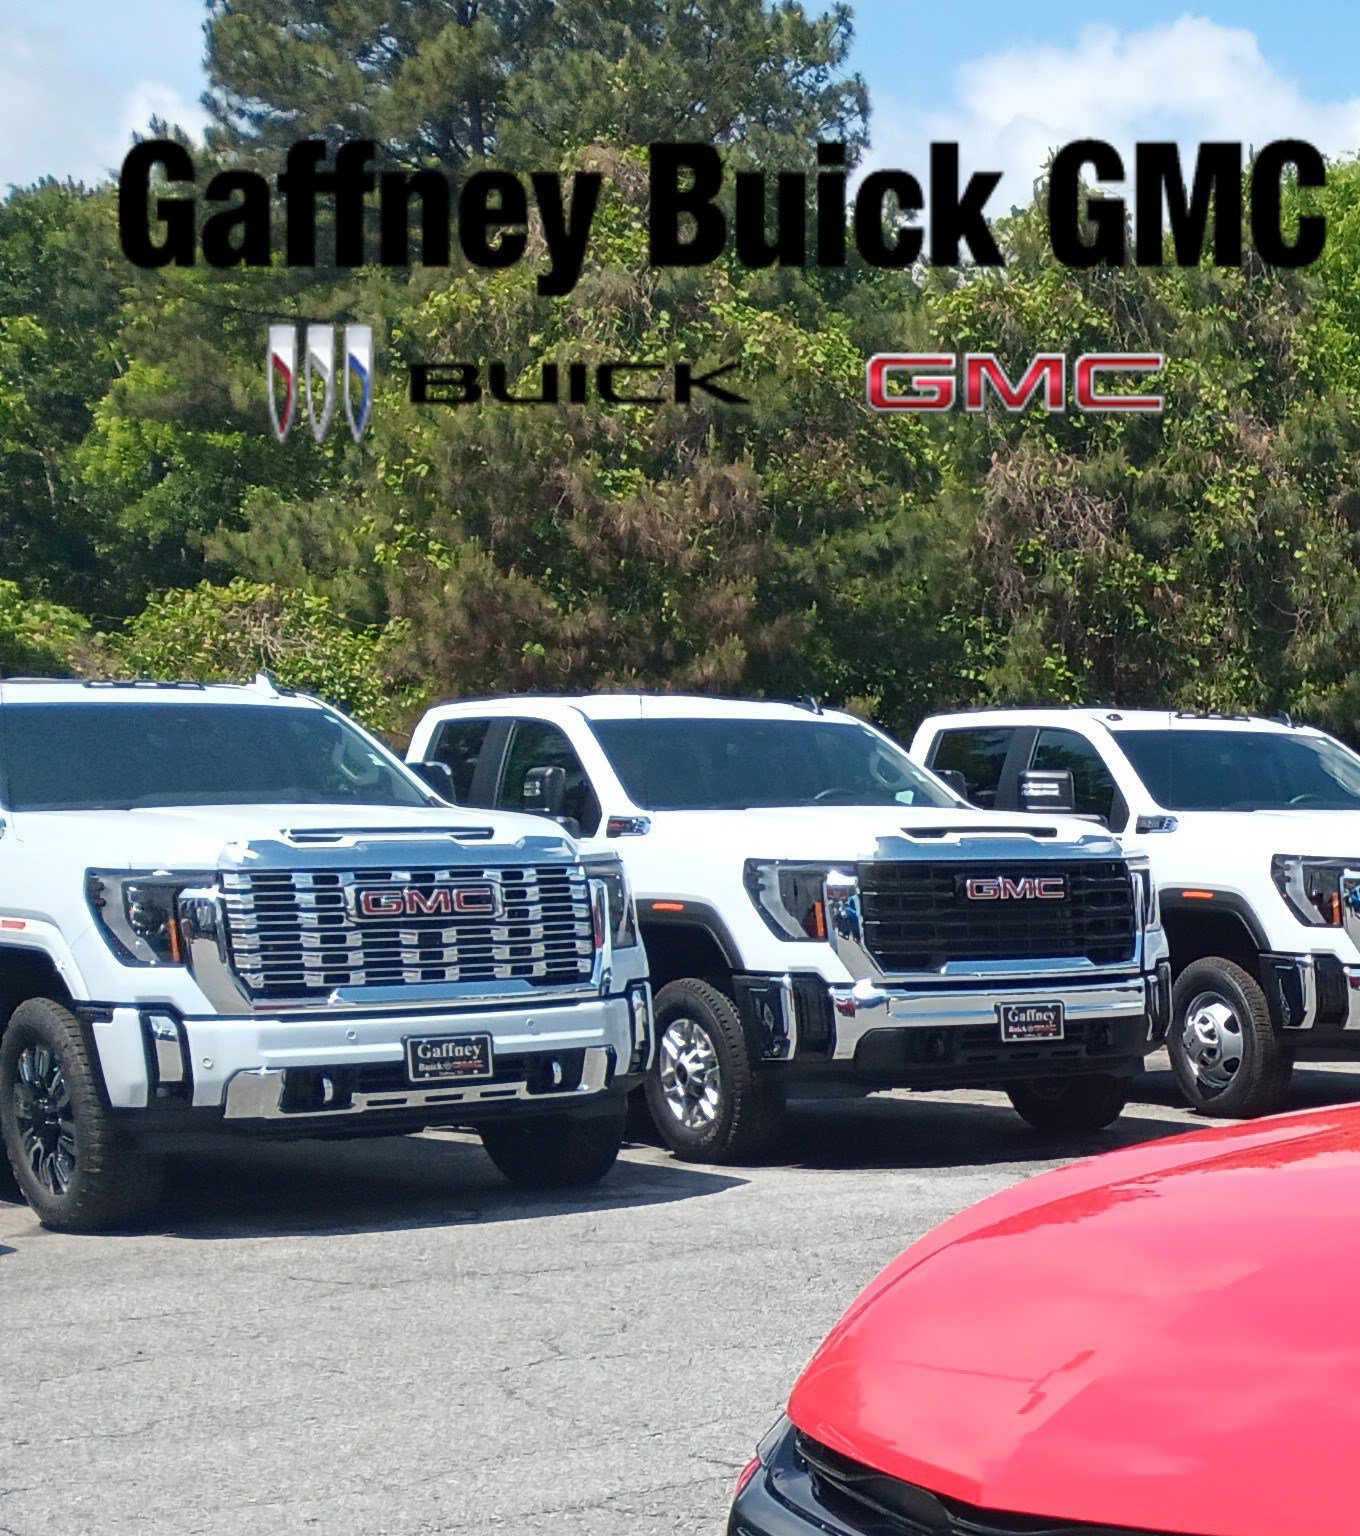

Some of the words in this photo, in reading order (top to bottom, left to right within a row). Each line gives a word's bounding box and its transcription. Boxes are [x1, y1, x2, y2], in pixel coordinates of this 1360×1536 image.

[966, 876, 1065, 900] GMC
[359, 887, 493, 916] GMC
[417, 1042, 482, 1060] Gaffney
